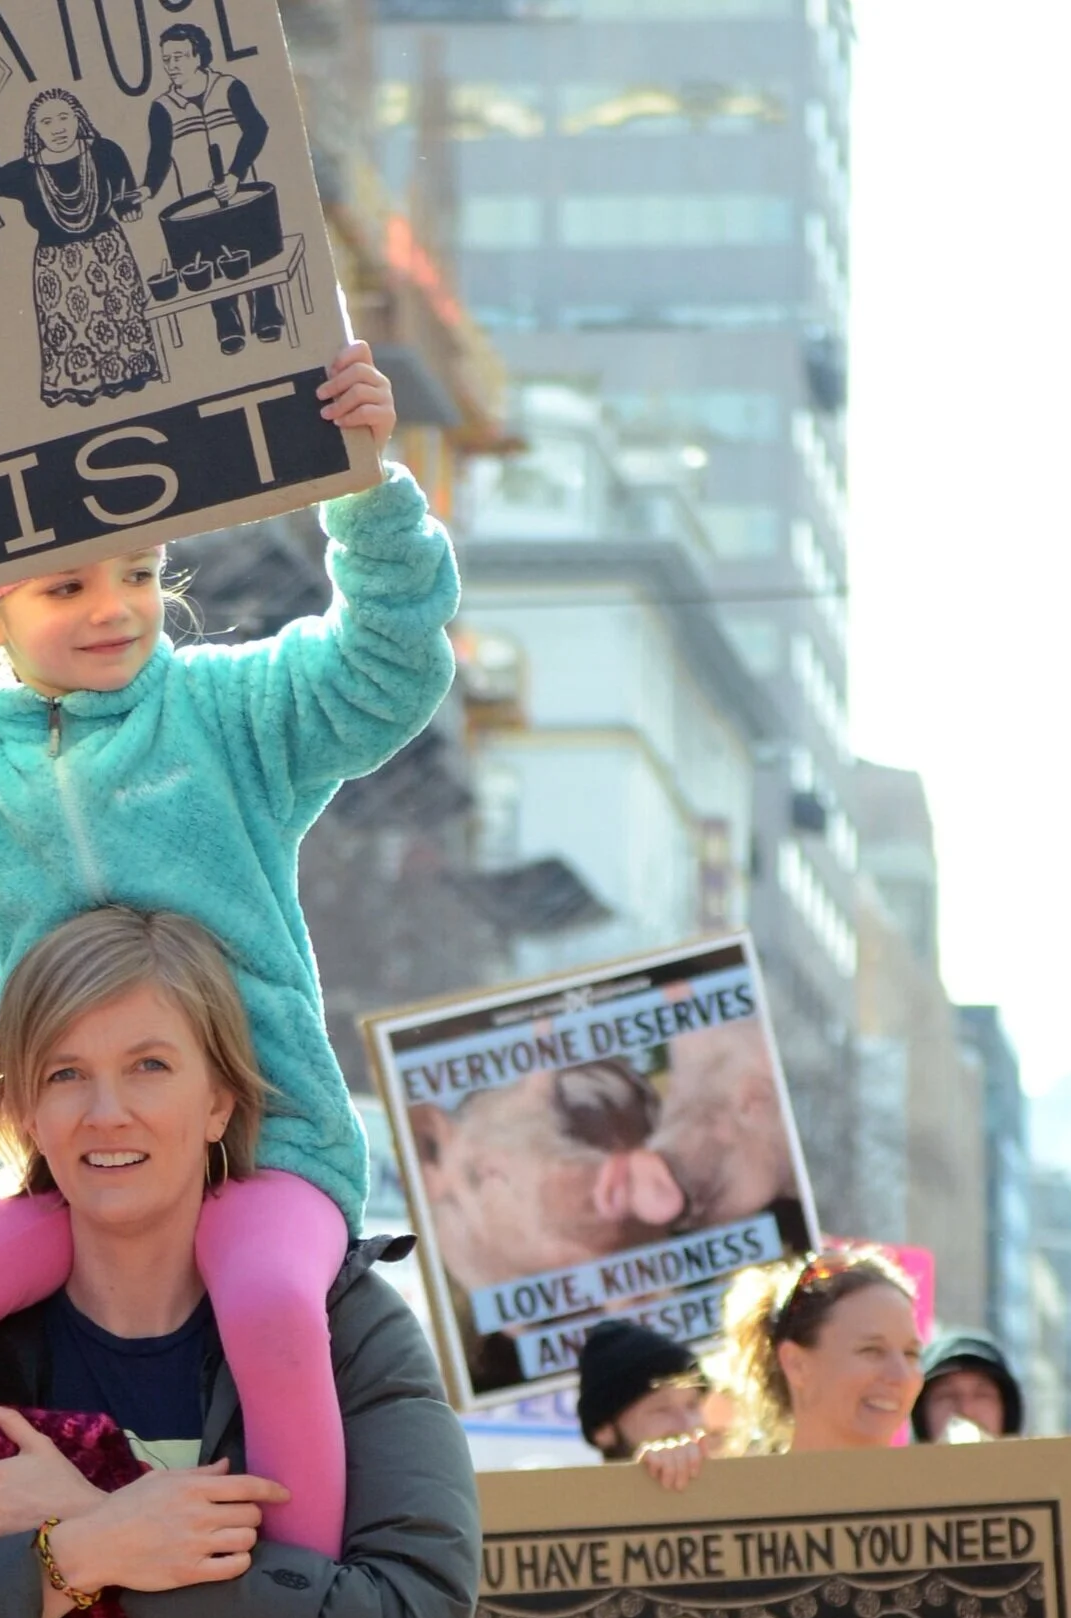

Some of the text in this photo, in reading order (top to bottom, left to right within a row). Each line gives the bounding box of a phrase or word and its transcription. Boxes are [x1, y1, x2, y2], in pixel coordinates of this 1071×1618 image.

[56, 0, 259, 97] TOL
[401, 1027, 579, 1101] EVERYONE
[588, 983, 755, 1056] DESERVES
[493, 1226, 766, 1323] LOVE, KINDNESS
[515, 1540, 611, 1589] HAVE
[624, 1532, 726, 1580] MORE
[733, 1526, 835, 1577] THAN
[843, 1522, 916, 1569] YOU
[927, 1516, 1037, 1564] NEED
